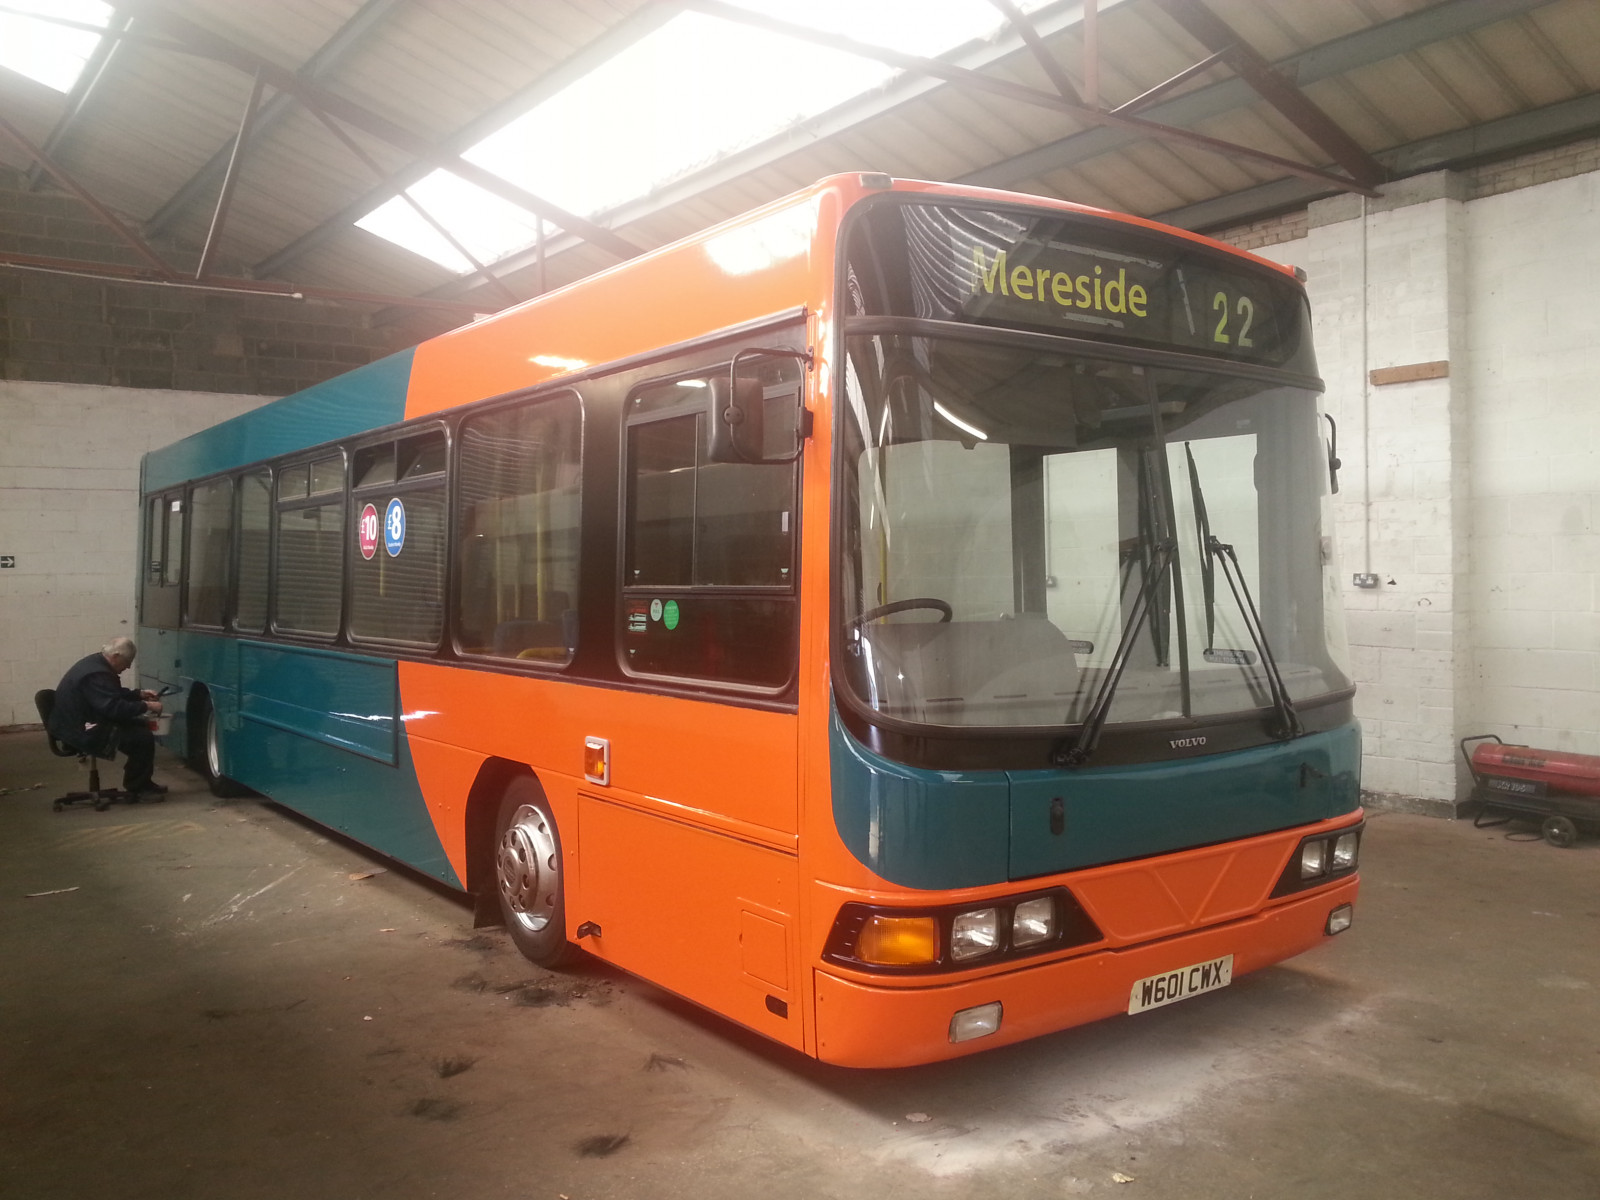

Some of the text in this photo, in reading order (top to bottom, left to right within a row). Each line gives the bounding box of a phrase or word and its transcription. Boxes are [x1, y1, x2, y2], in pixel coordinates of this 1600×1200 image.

[971, 246, 1147, 317] Mereside
[1213, 291, 1254, 348] 22
[361, 515, 377, 541] £10
[387, 505, 402, 541] £8
[1169, 736, 1207, 749] VOLVO
[1141, 960, 1224, 1008] W601 CWX
